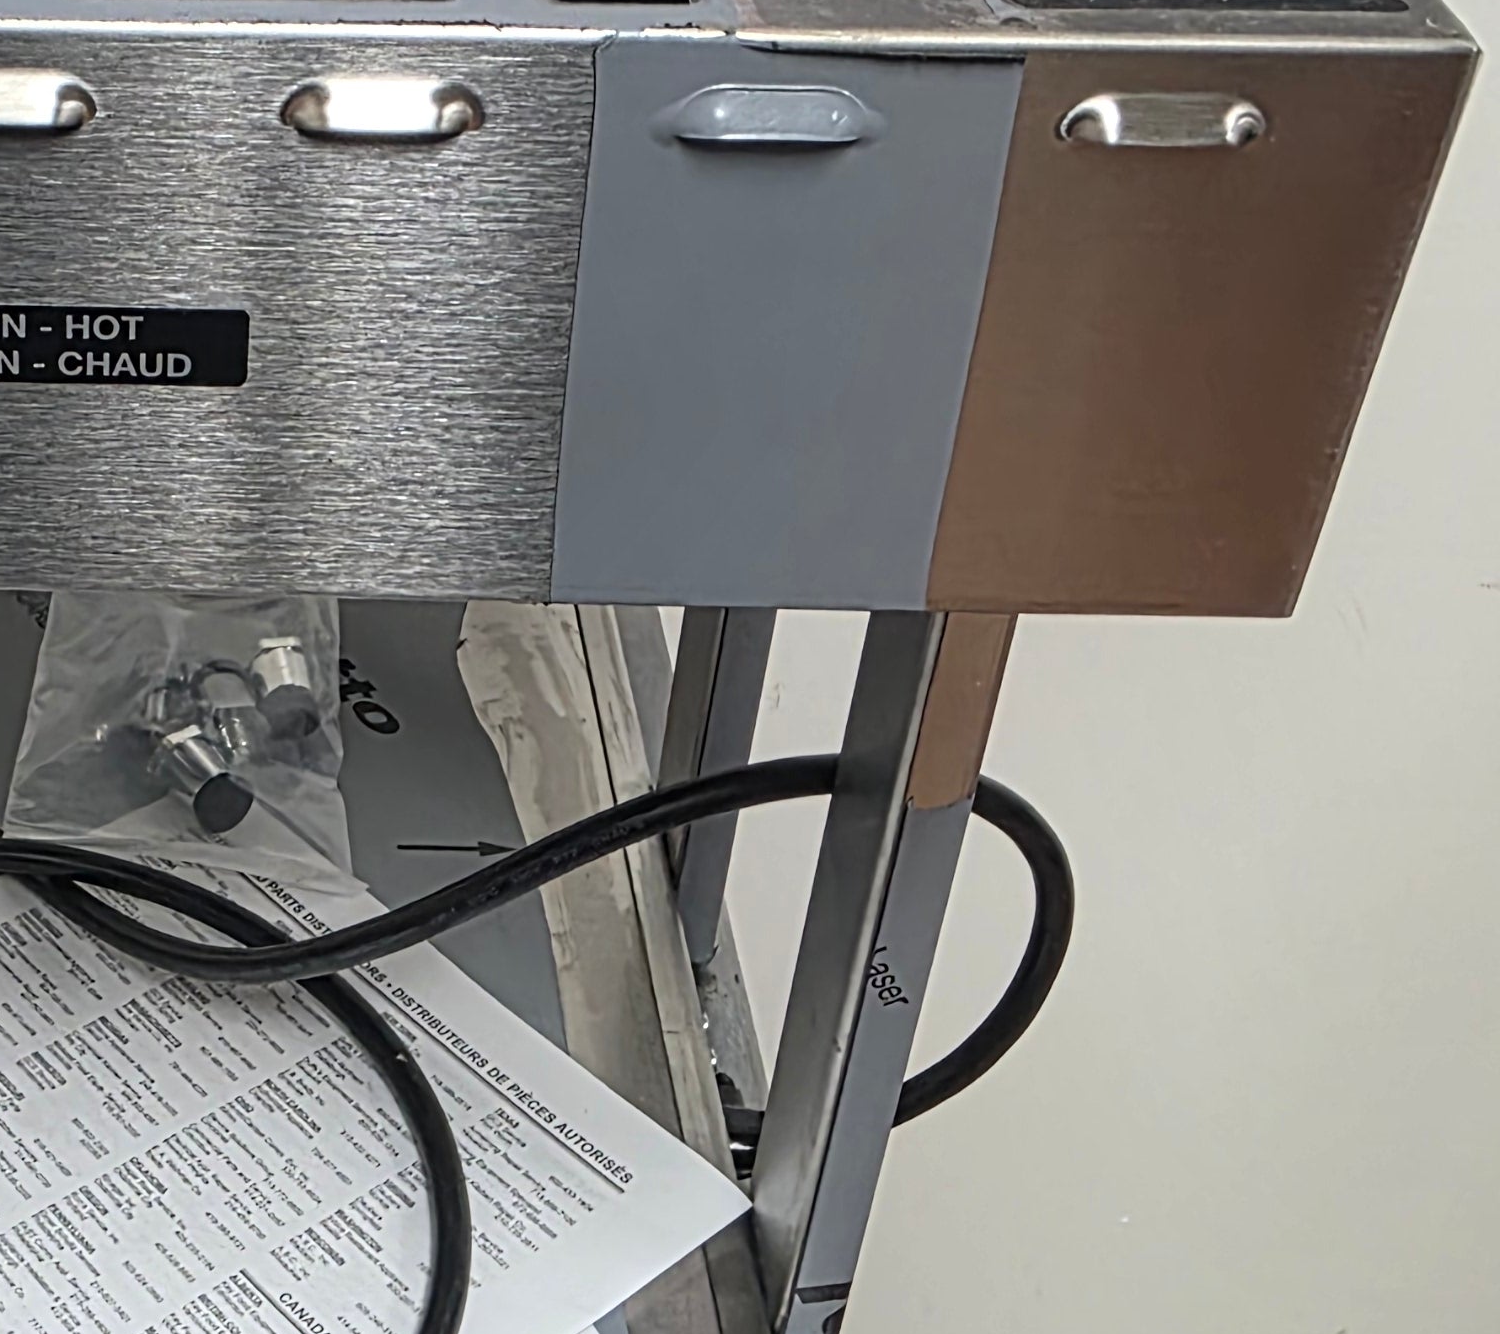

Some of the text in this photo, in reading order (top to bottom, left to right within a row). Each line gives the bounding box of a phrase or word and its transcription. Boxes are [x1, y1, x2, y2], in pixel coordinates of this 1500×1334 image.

[65, 314, 144, 341] HOT
[57, 351, 192, 378] CHAUD
[265, 880, 307, 914] PARTS
[391, 987, 489, 1069] DISTRIBUTEURS
[486, 1067, 510, 1085] DE
[506, 1083, 557, 1124] PIÈCES
[553, 1123, 633, 1188] AUTORISÉS
